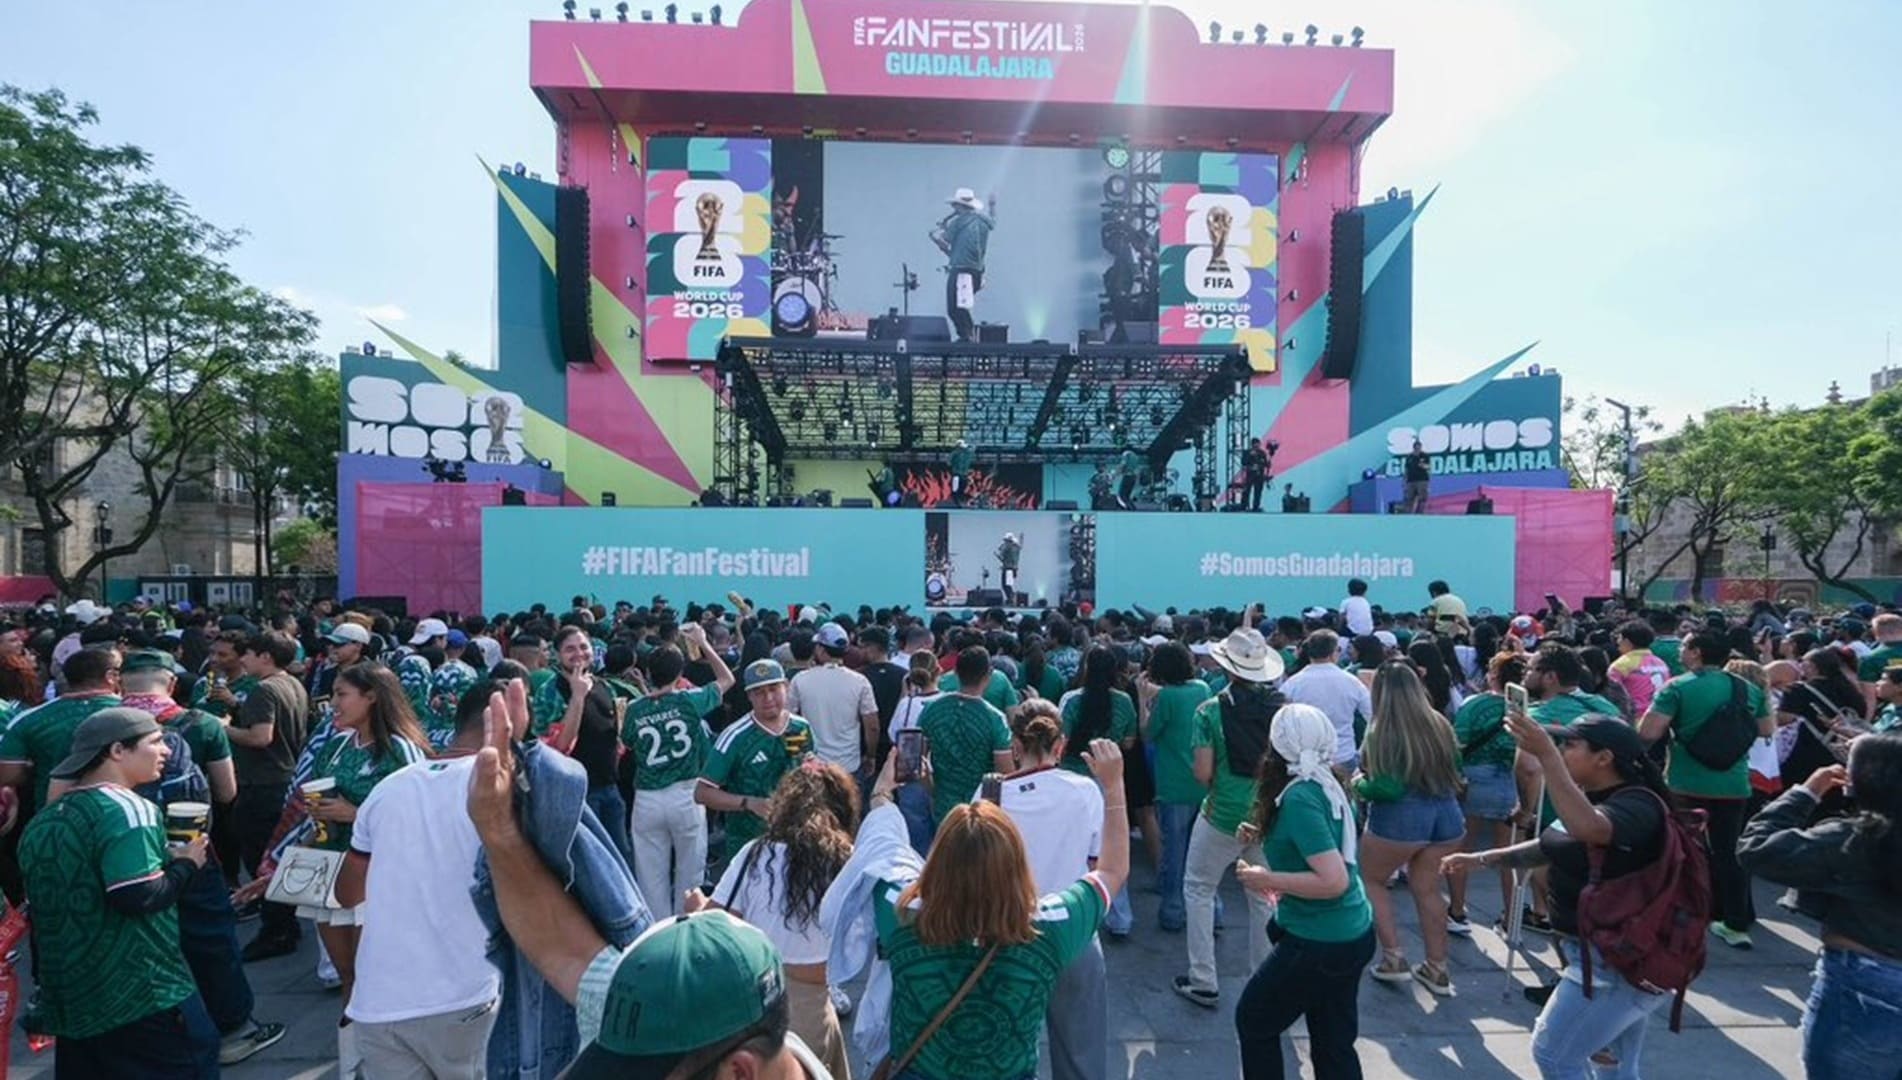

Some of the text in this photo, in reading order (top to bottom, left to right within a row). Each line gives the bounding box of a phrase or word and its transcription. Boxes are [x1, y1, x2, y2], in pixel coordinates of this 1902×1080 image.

[853, 17, 865, 46] FIFA
[886, 52, 1054, 79] GUADALAJARA
[693, 265, 725, 277] FIFA
[1203, 277, 1234, 289] FIFA
[673, 290, 744, 302] WORLD CUP
[1184, 302, 1251, 312] WORLD CUP
[672, 302, 744, 319] 2026
[1183, 313, 1251, 329] 2026
[1387, 417, 1553, 456] SOMOS
[582, 546, 810, 576] #FIFAFanFestival
[1200, 552, 1413, 581] #SomosGuadalajara
[638, 720, 692, 766] 23
